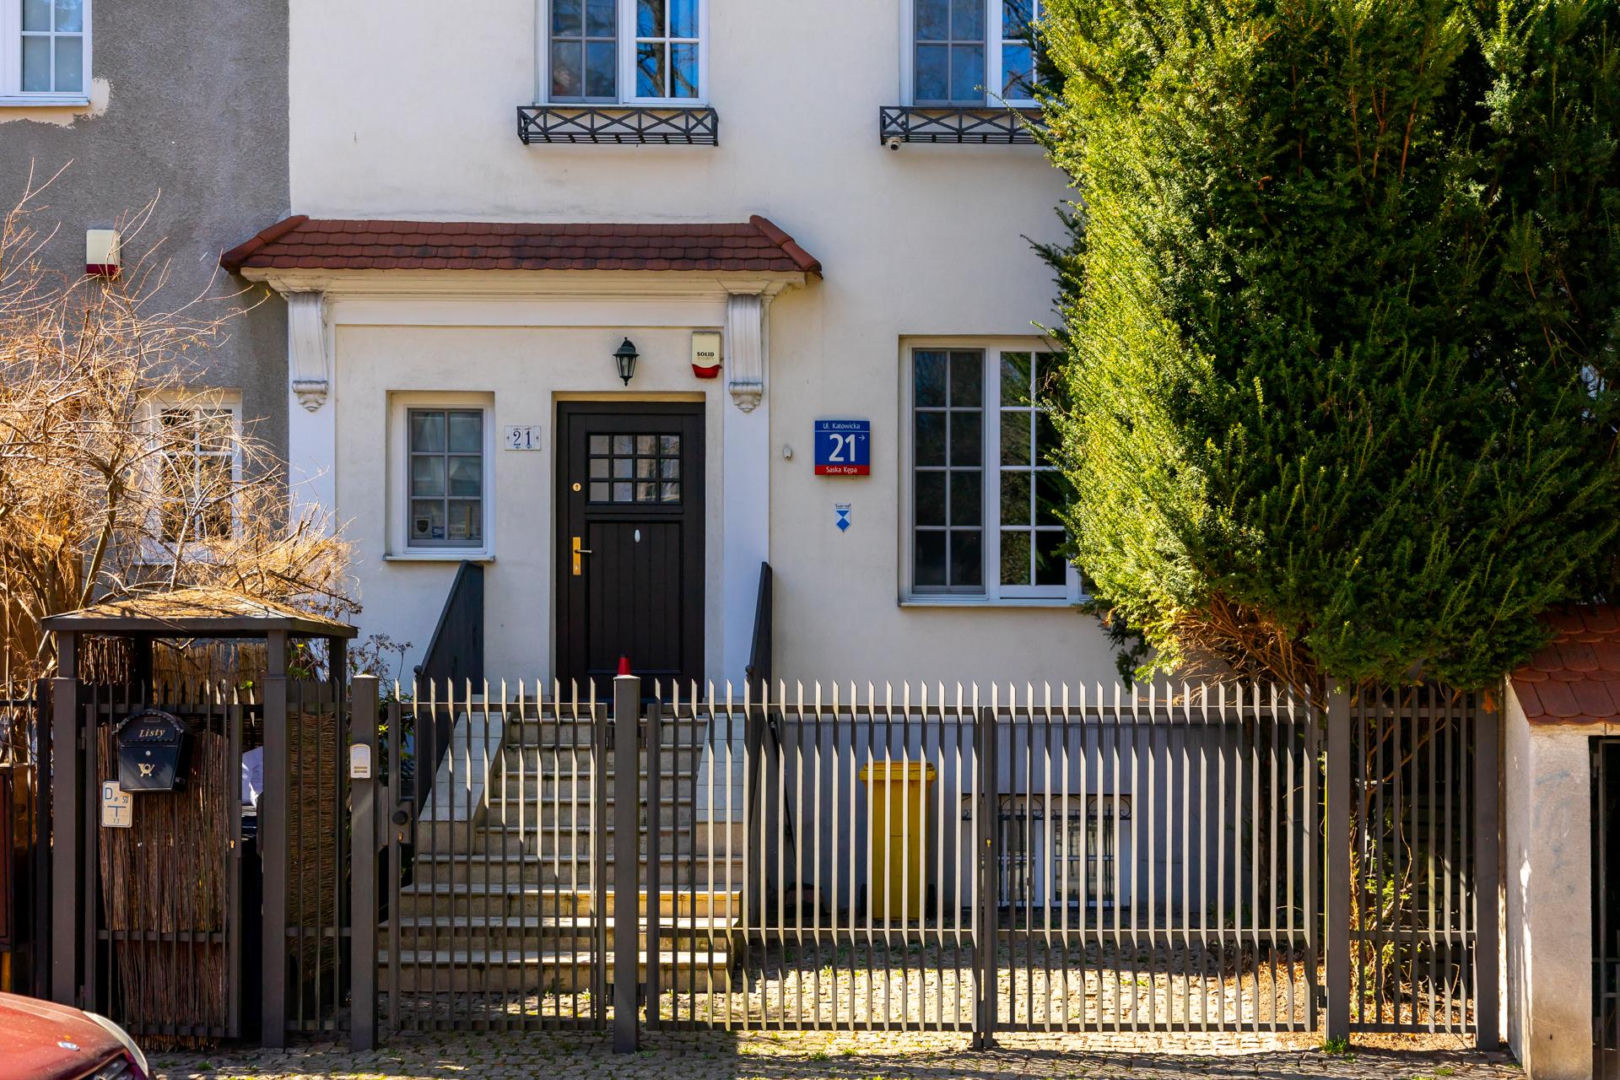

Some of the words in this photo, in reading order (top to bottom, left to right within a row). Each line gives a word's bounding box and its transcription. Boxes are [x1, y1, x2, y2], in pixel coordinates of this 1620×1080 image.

[832, 422, 861, 430] Katowicka
[512, 430, 531, 446] 21
[829, 433, 855, 462] 21
[139, 728, 166, 738] Listy
[105, 787, 113, 800] D
